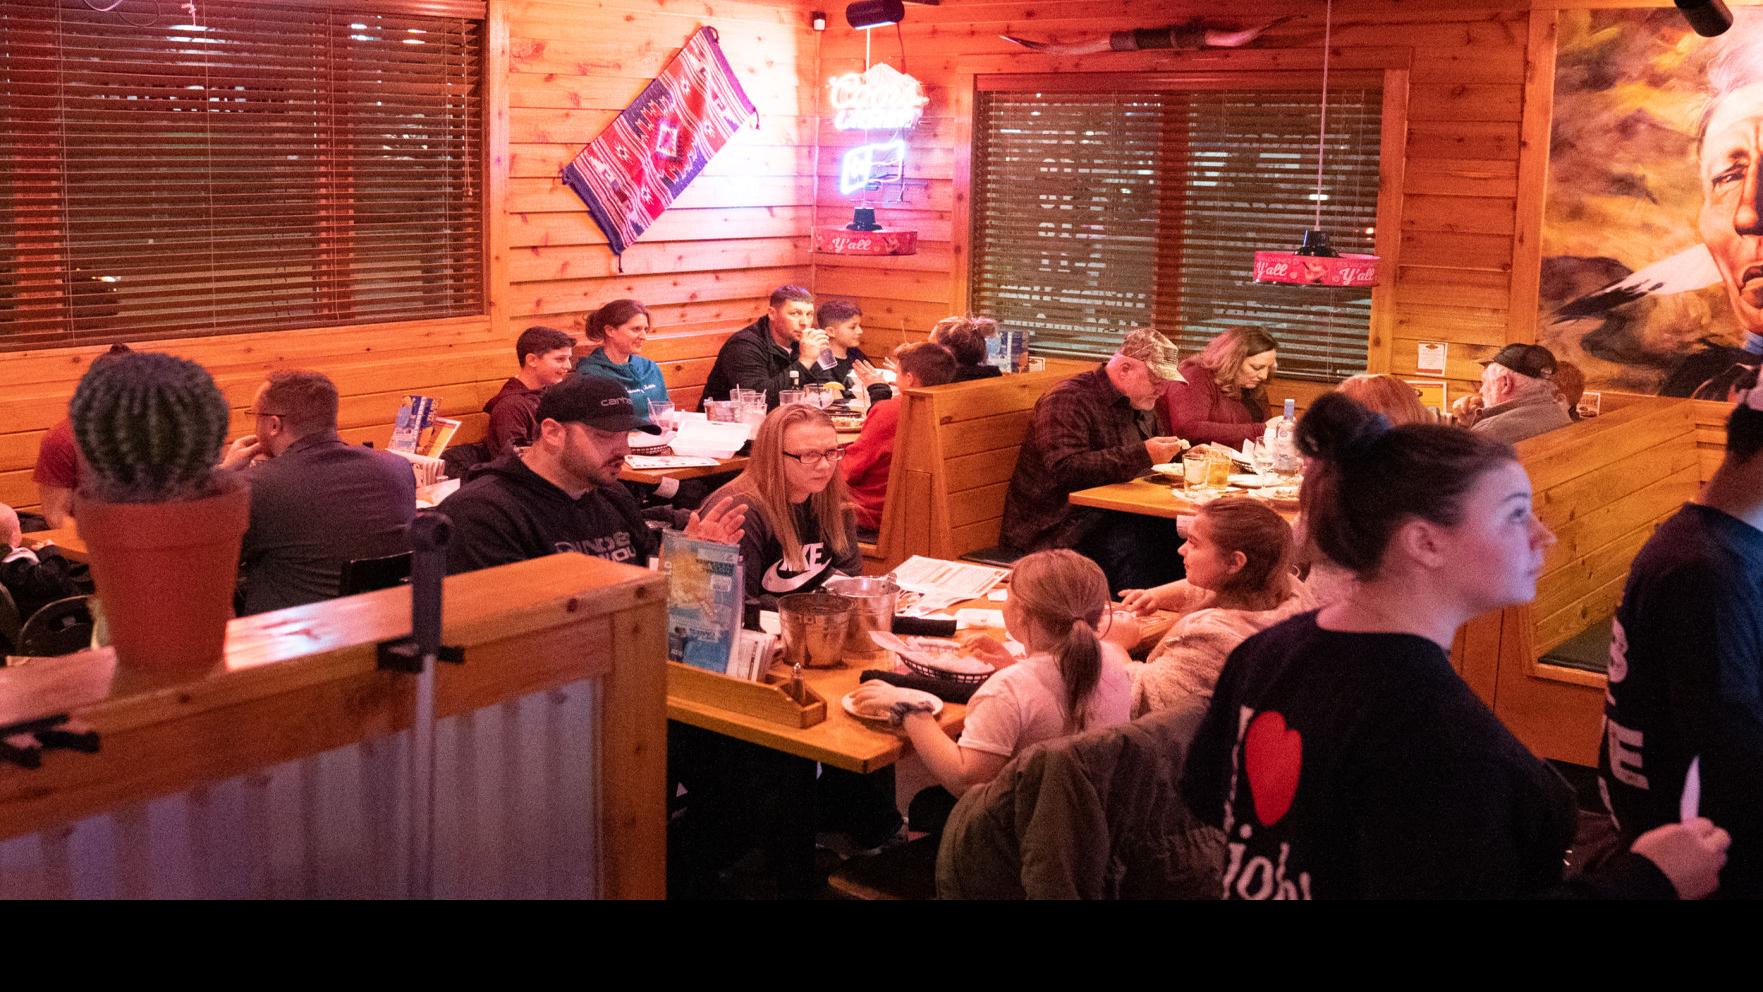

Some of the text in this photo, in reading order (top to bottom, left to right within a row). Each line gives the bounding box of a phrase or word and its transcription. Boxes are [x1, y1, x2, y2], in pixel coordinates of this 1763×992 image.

[832, 237, 872, 253] Y'all
[1339, 267, 1375, 285] Y'all
[779, 542, 824, 571] KE
